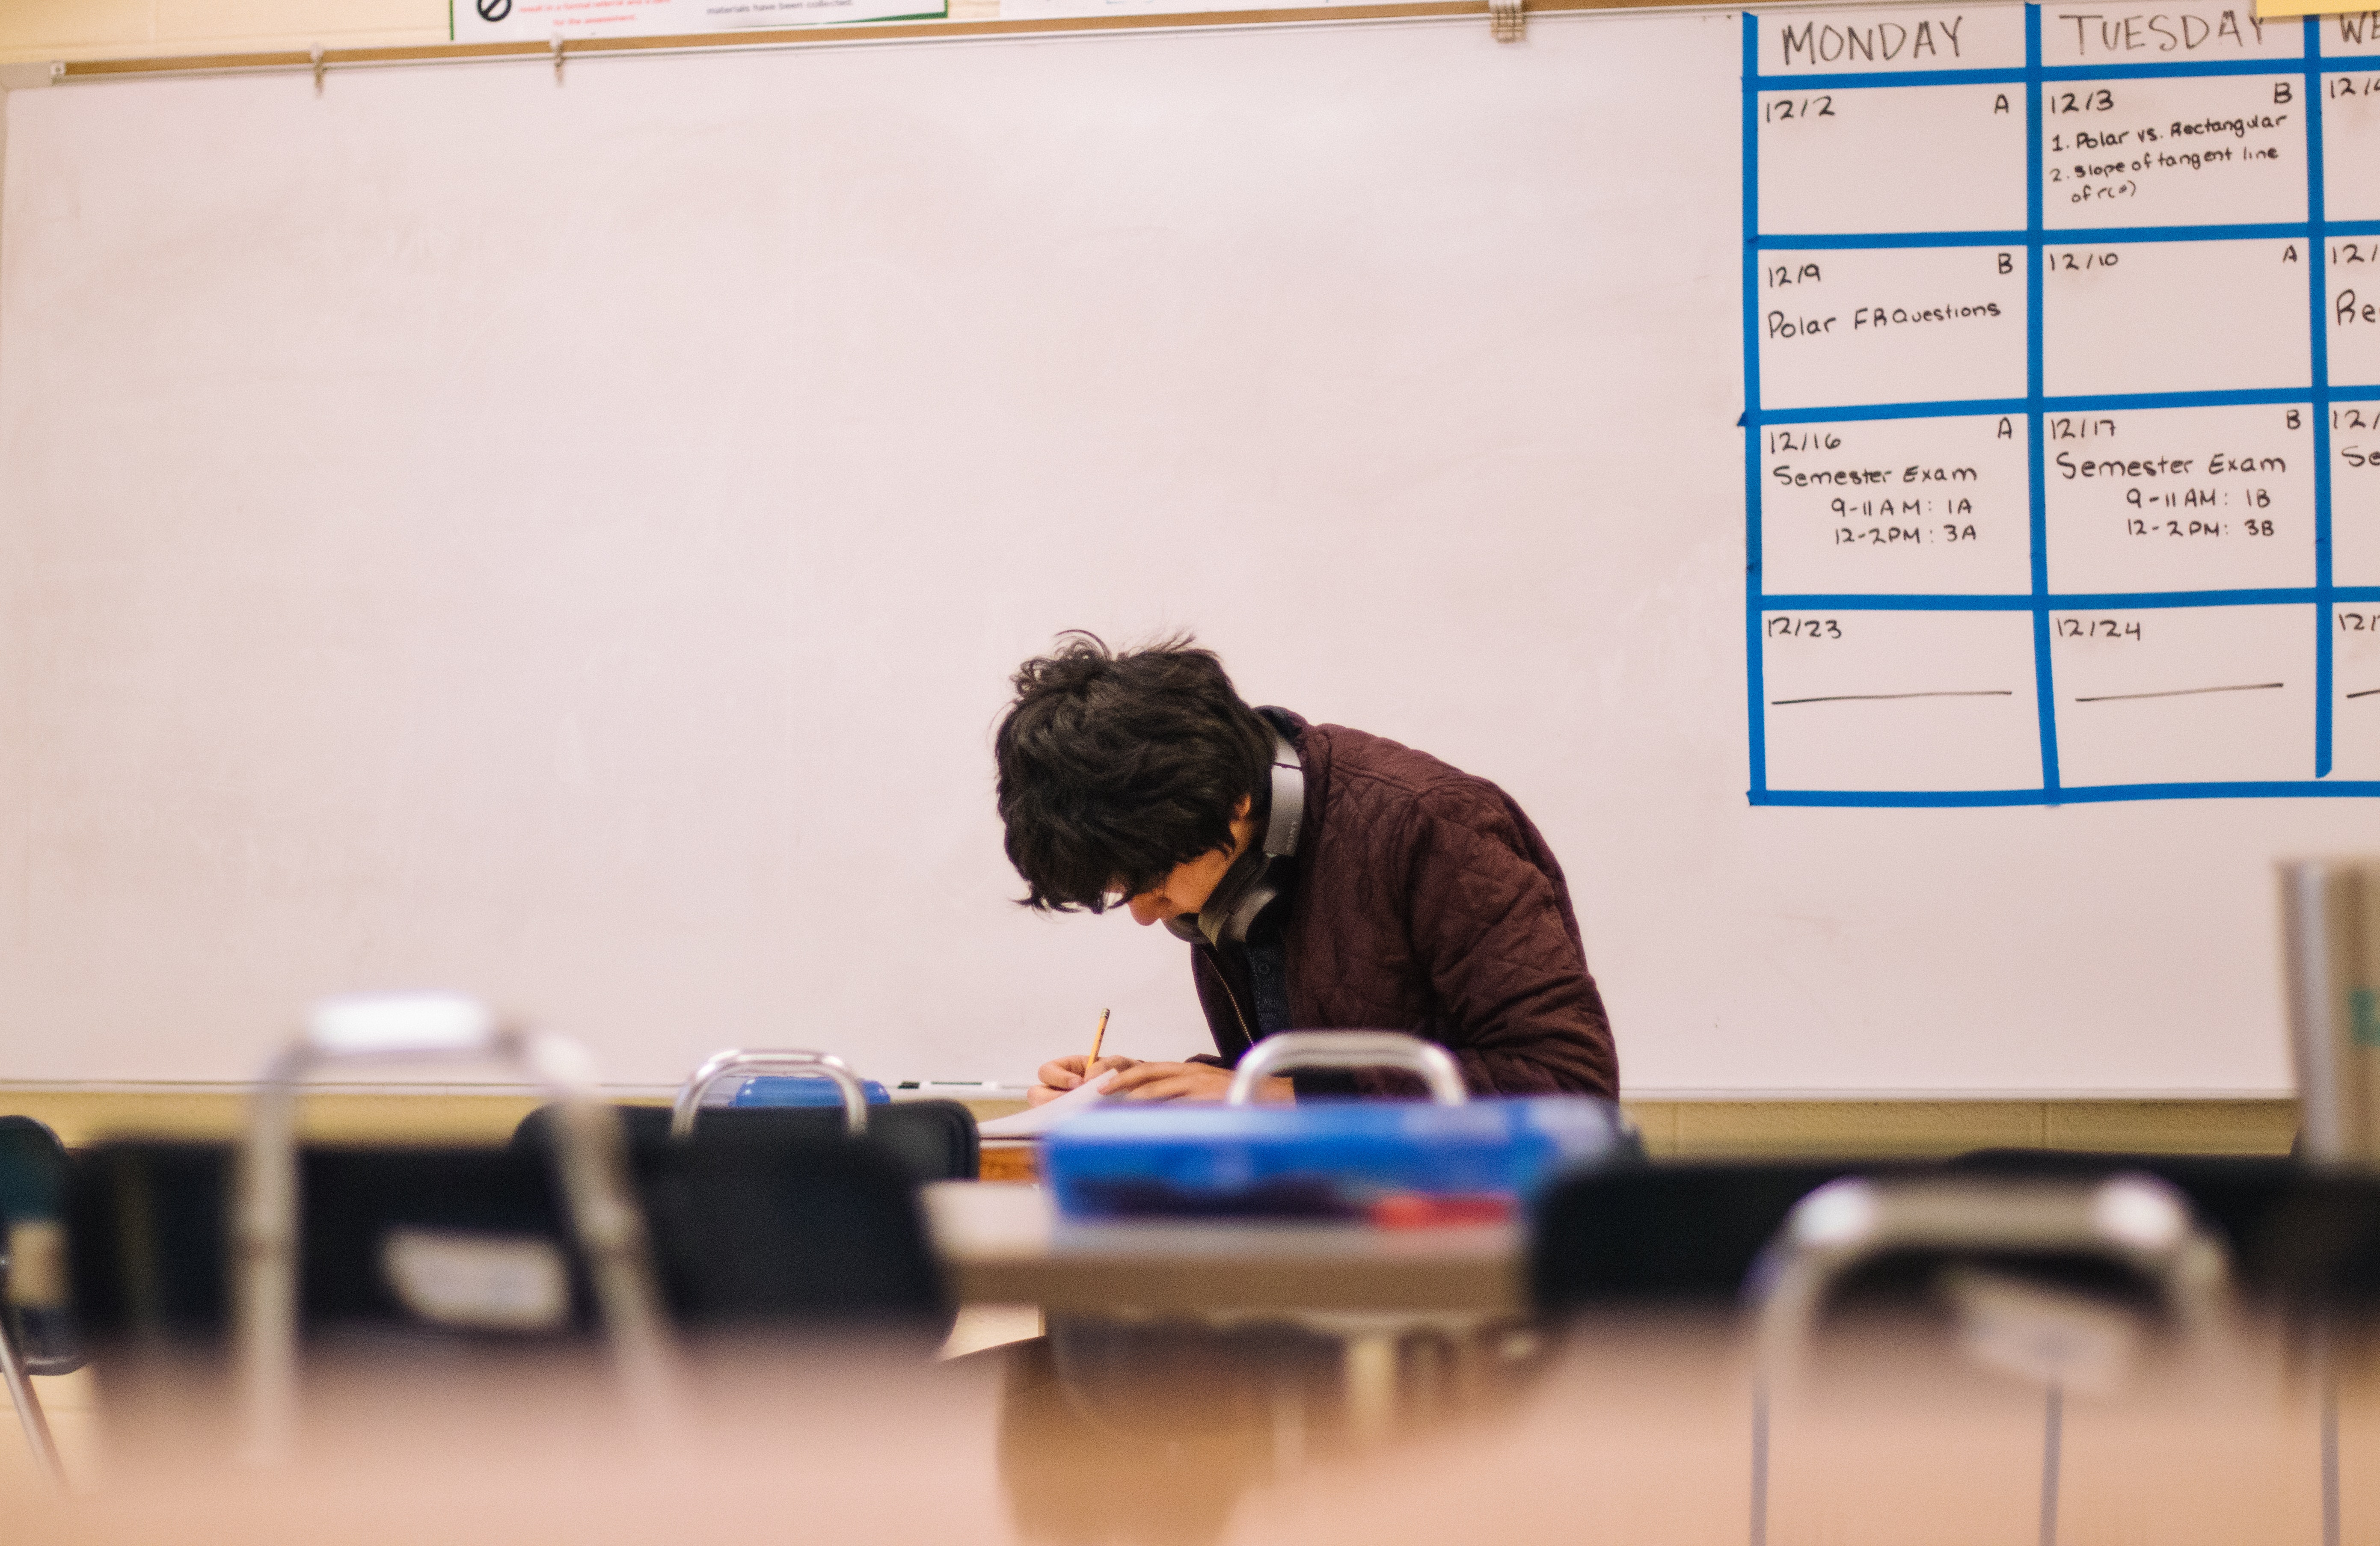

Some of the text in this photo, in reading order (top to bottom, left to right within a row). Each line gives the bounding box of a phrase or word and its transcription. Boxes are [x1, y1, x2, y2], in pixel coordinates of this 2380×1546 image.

[1782, 16, 1962, 65] MONDAY
[2059, 10, 2264, 54] TUESDAY
[1994, 94, 2009, 114] A
[2052, 89, 2114, 114] 12/3
[2273, 82, 2292, 104] B
[1766, 95, 1835, 123] 12/2
[2076, 131, 2129, 149] Polar
[2137, 127, 2163, 143] vs.
[2170, 115, 2287, 138] Rectangular
[2131, 152, 2151, 171] of
[2158, 148, 2232, 170] tangent
[2243, 147, 2278, 160] line
[2071, 184, 2091, 203] of
[1998, 253, 2013, 275] B
[2050, 253, 2118, 271] 12/10
[2283, 245, 2297, 262] A
[1769, 264, 1821, 287] 12/9
[1768, 310, 1836, 338] Polar
[1997, 417, 2012, 439] A
[2051, 418, 2116, 440] 12/17
[2286, 409, 2301, 430] B
[1771, 432, 1841, 454] 12/16
[1773, 465, 1977, 487] Semester Exam
[2056, 451, 2286, 480] Semester Exam
[1948, 498, 1972, 514] 1A
[2246, 489, 2270, 508] 1B
[1944, 524, 1976, 542] 3A
[2244, 519, 2274, 536] 3B
[1768, 616, 1842, 639] 12/23
[2057, 619, 2140, 641] 12/24
